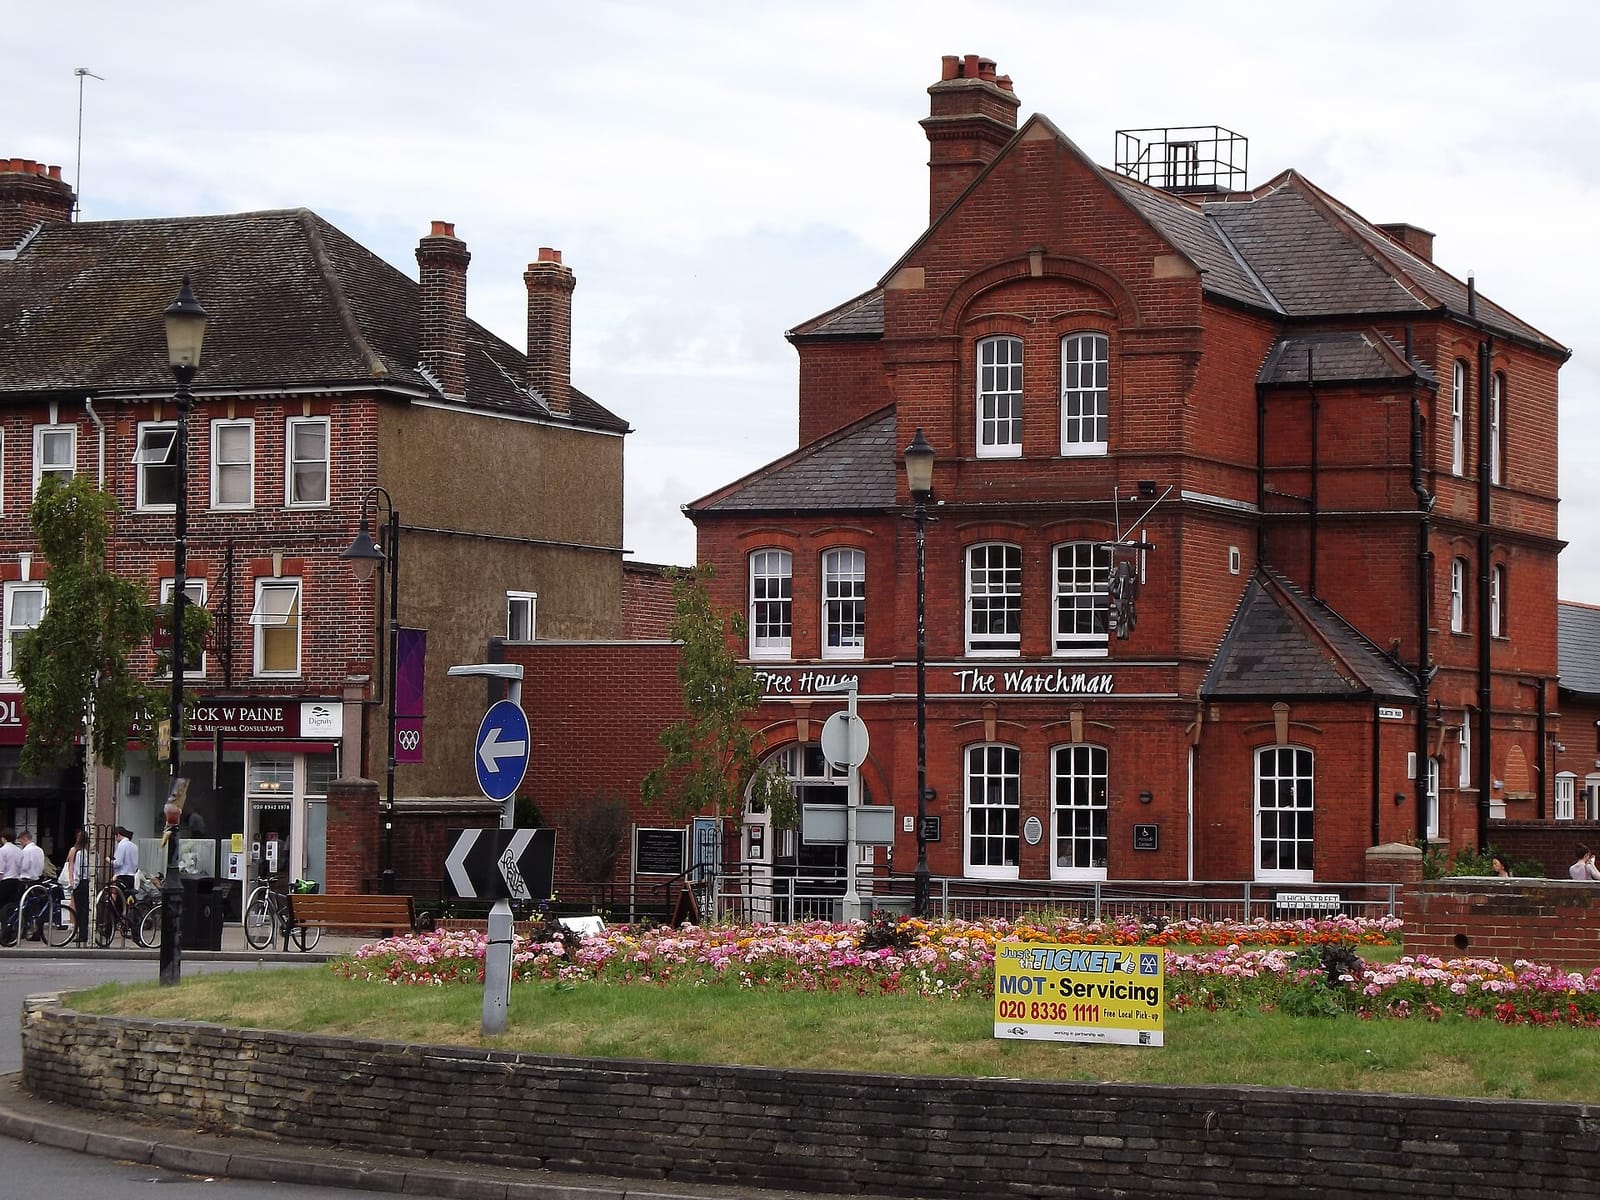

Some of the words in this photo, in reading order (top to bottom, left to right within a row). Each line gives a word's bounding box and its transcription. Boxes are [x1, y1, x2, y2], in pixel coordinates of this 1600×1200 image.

[753, 672, 792, 692] Free
[953, 668, 995, 693] The
[1004, 669, 1113, 693] Watchman
[222, 707, 236, 720] W
[240, 707, 283, 721] PAINE
[309, 717, 332, 726] Dignity
[1000, 947, 1030, 959] Just
[1031, 948, 1122, 973] TICKET
[1019, 959, 1041, 970] the
[1000, 975, 1046, 995] MOT
[1059, 978, 1159, 1006] Servicing
[1000, 1000, 1026, 1019] 020
[1031, 1002, 1067, 1021] 8336
[1072, 1004, 1099, 1022] 1111
[1103, 1008, 1116, 1018] Free
[1118, 1009, 1133, 1019] Local
[1135, 1010, 1159, 1022] Pick-up
